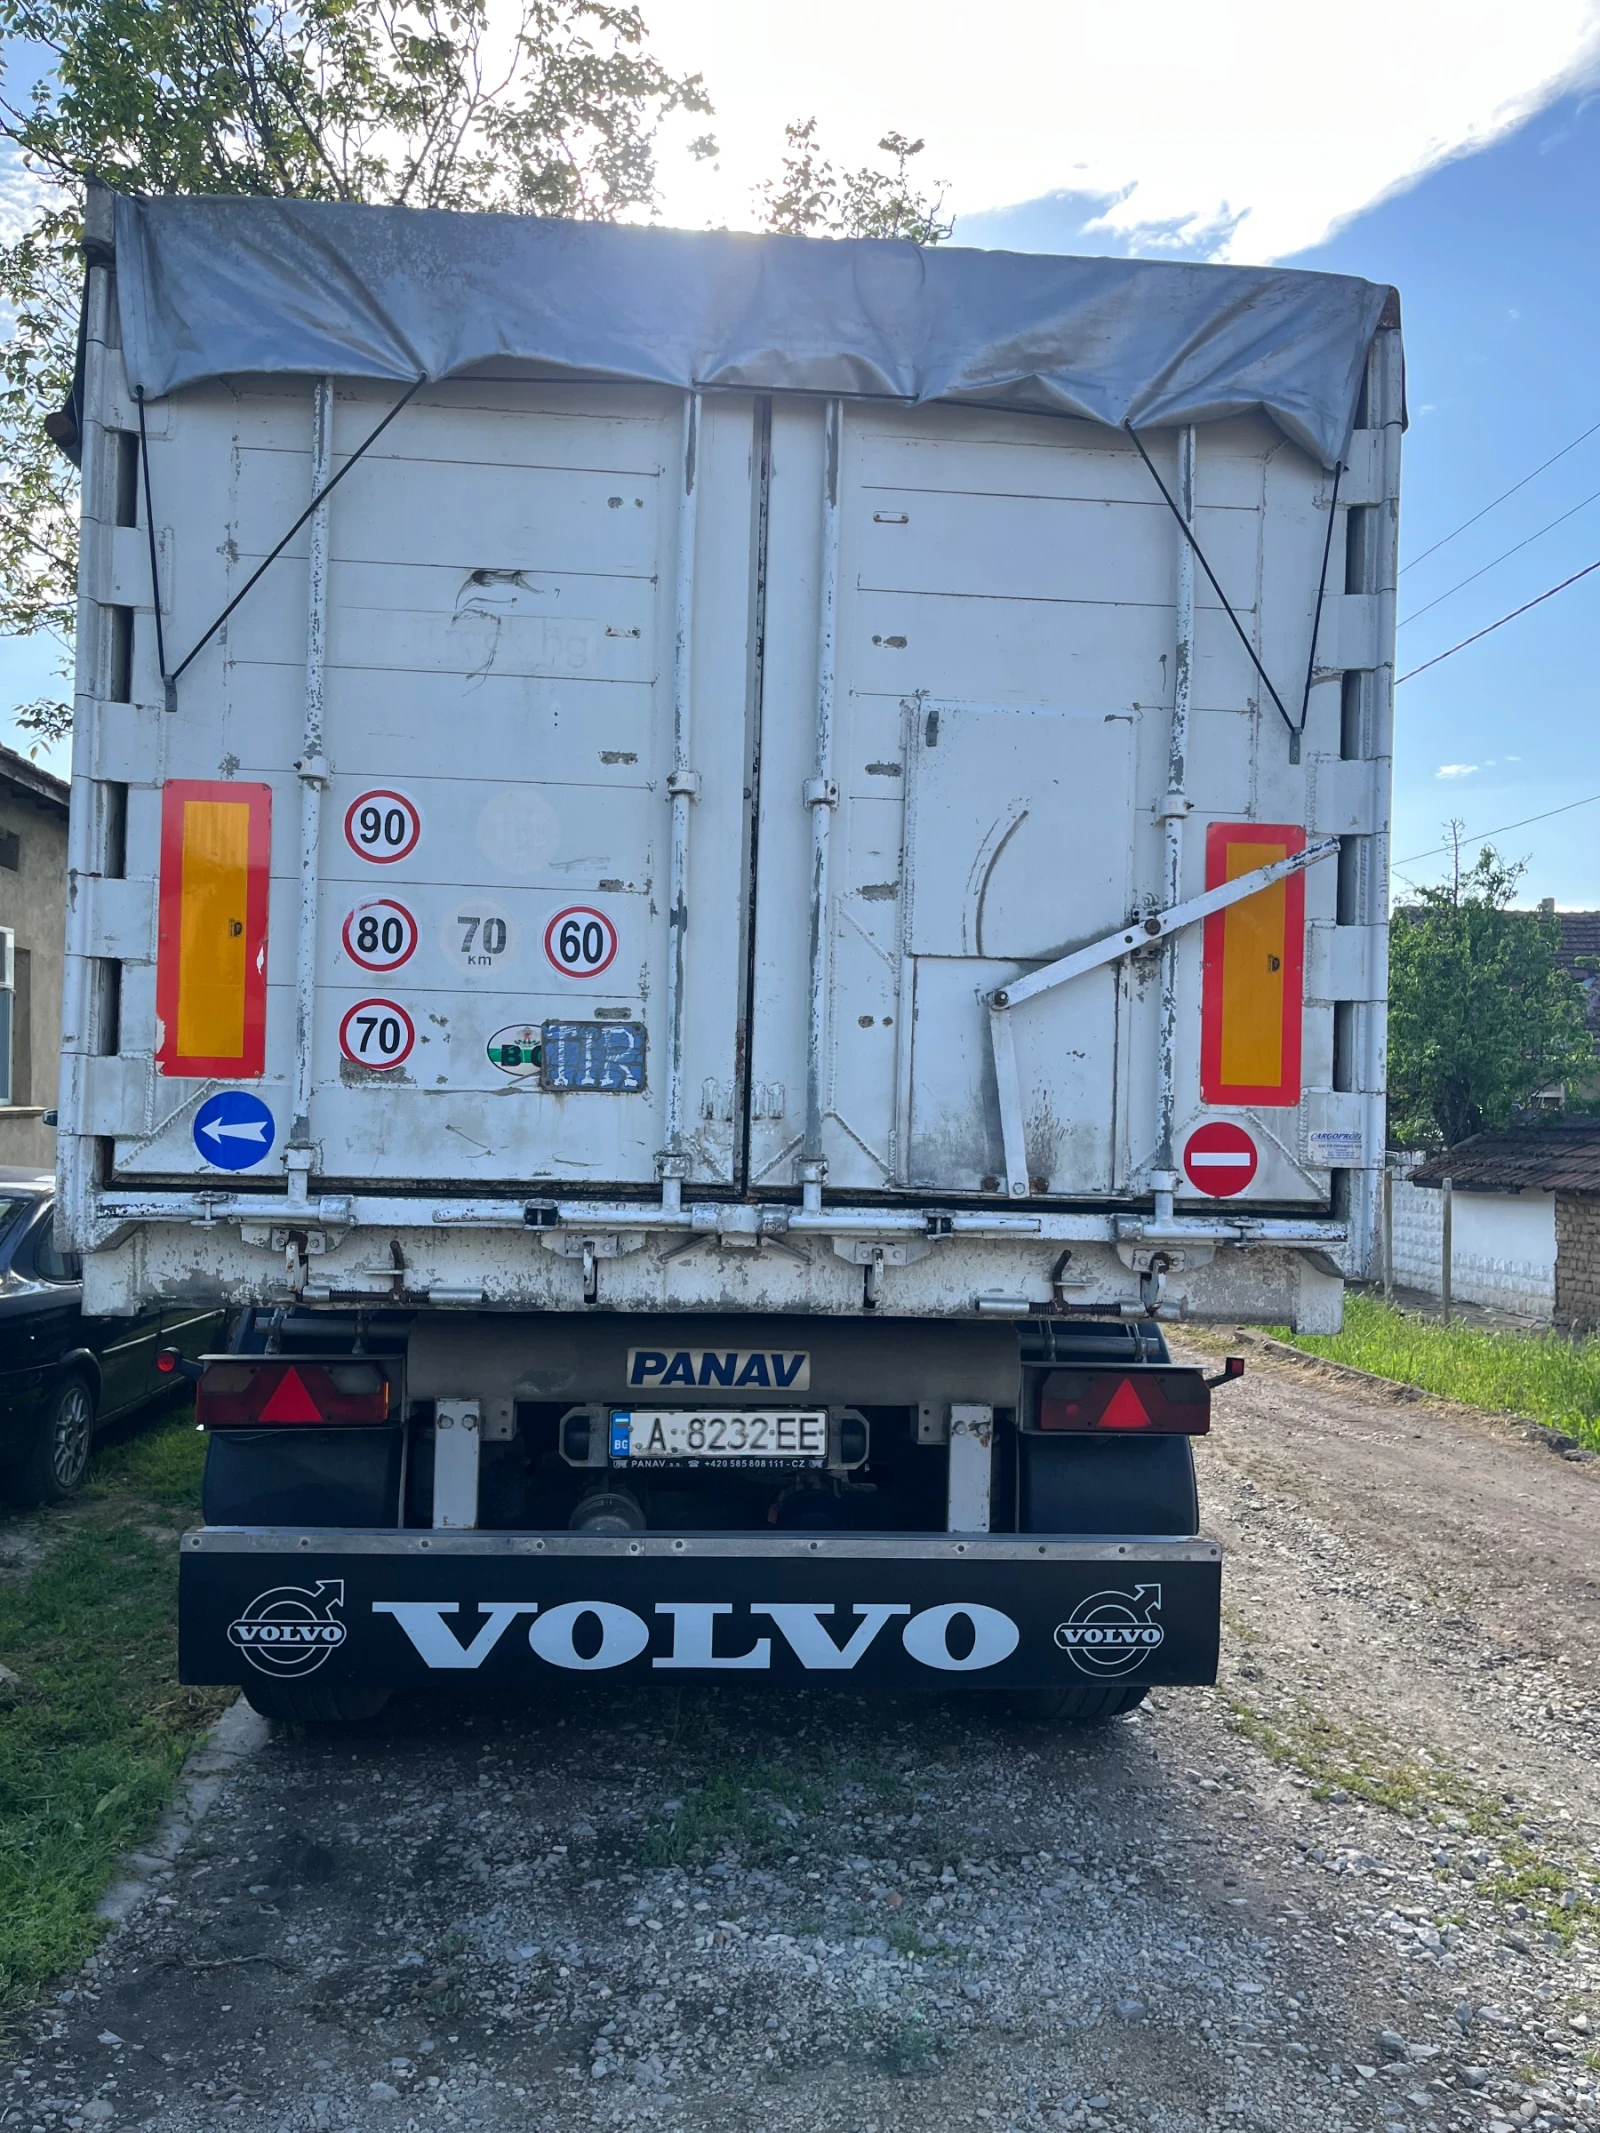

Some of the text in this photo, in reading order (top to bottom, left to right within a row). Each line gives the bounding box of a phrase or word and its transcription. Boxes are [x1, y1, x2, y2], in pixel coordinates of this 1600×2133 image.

[360, 807, 405, 845] 90
[357, 916, 404, 954] 80
[457, 916, 507, 954] 70
[560, 920, 604, 963] 60
[356, 1017, 401, 1054] 70
[547, 1025, 638, 1087] TIR
[630, 1351, 806, 1387] PANAV
[614, 1439, 628, 1450] BG
[648, 1417, 820, 1451] A 8232 EE
[704, 1460, 728, 1468] +420
[730, 1460, 747, 1468] 585
[749, 1460, 766, 1468] 808
[768, 1460, 784, 1468] 111
[791, 1460, 805, 1468] CZ
[234, 1625, 343, 1642] VOLVO
[372, 1600, 1020, 1671] VOLVO
[1061, 1627, 1161, 1643] VOLVO
